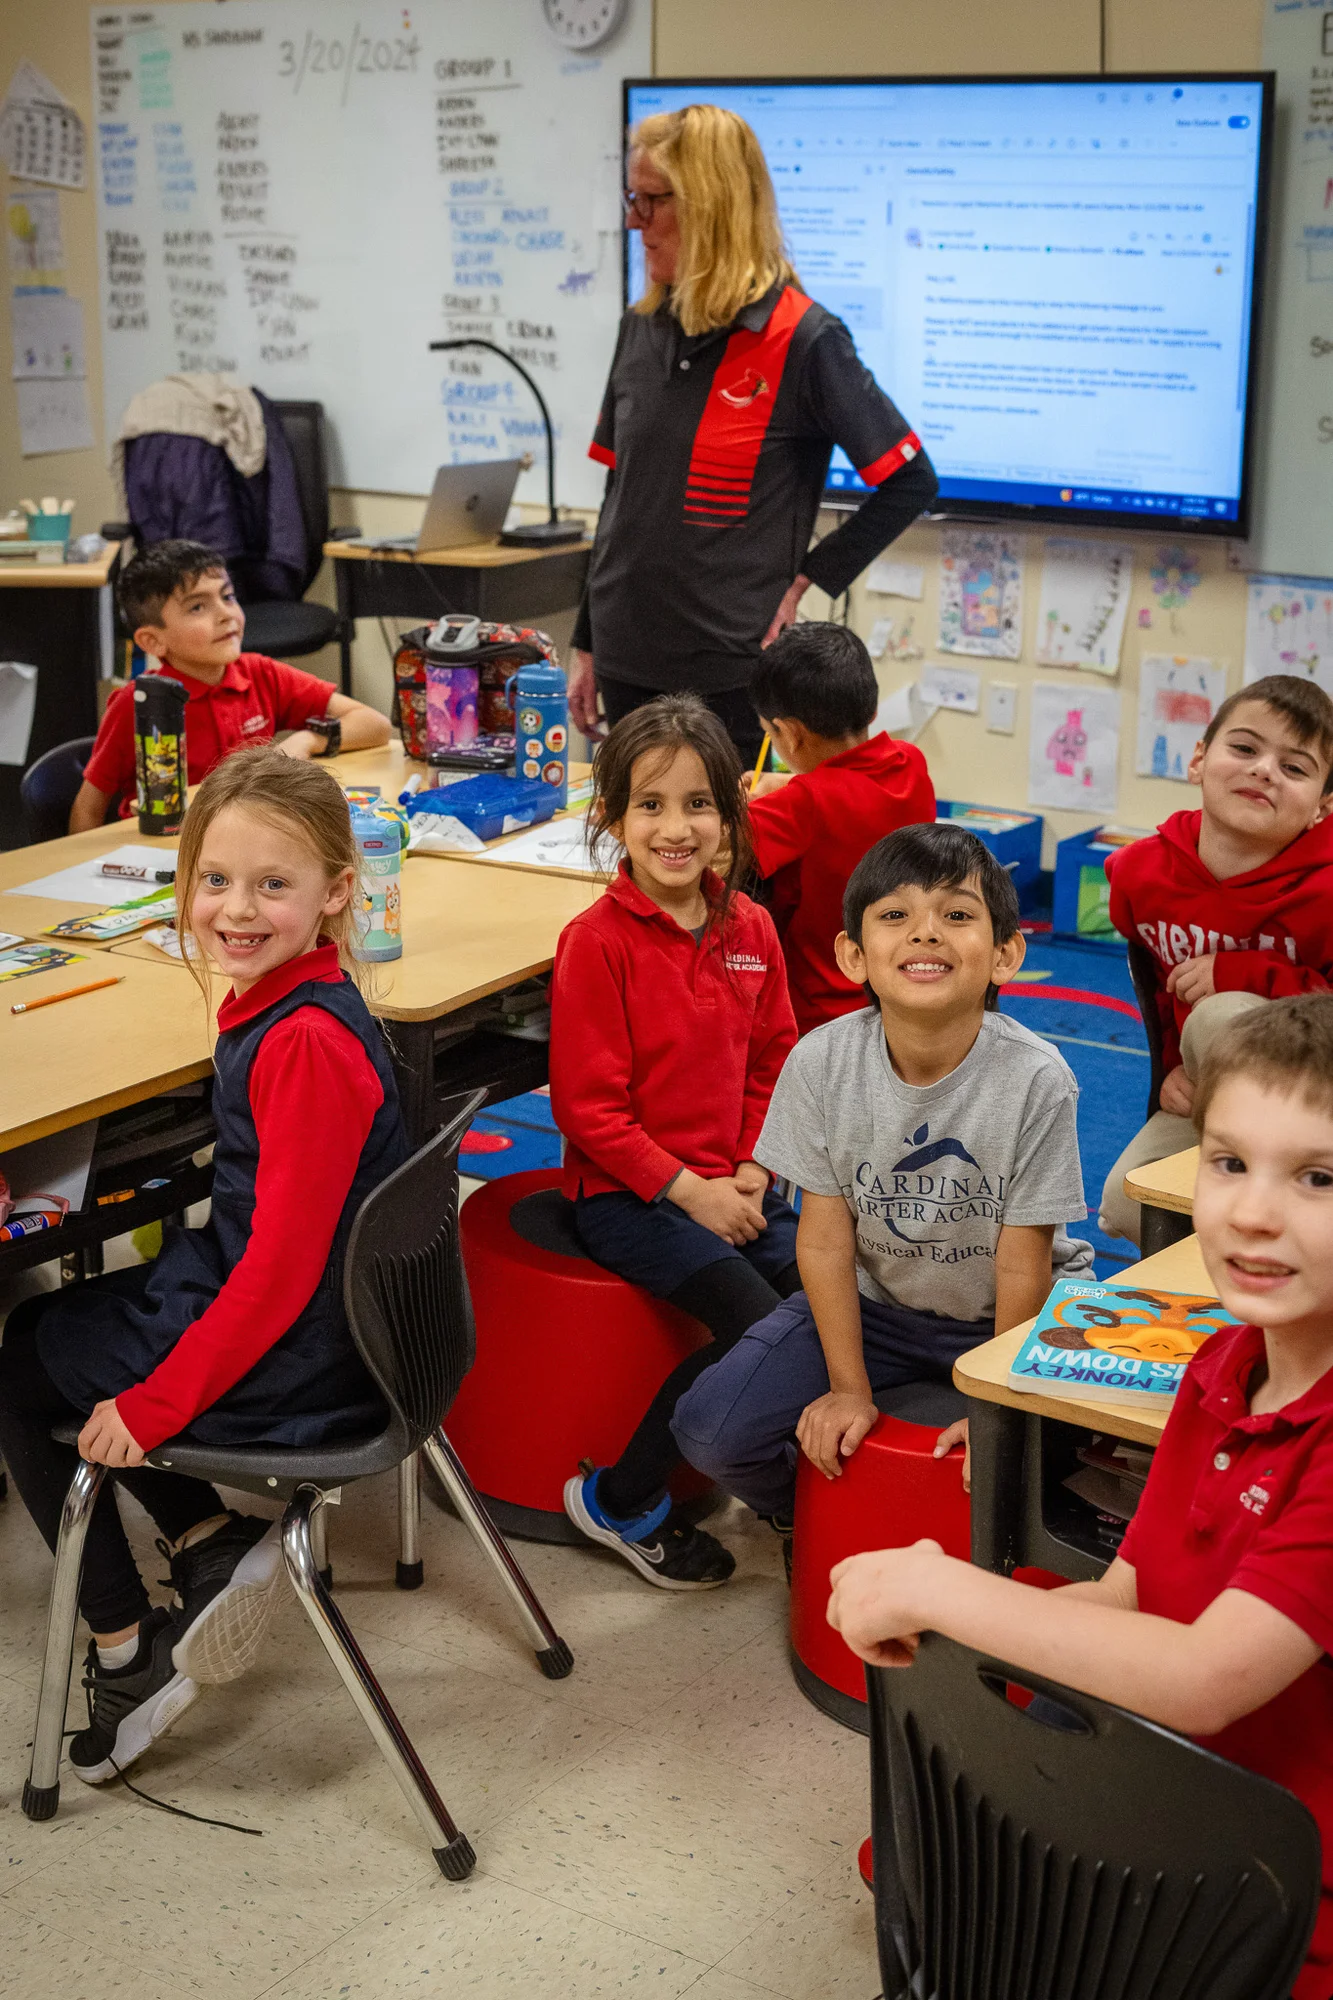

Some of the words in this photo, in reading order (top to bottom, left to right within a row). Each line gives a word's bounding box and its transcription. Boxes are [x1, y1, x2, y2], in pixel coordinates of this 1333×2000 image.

[278, 22, 421, 107] 3/20/2024
[930, 1244, 998, 1264] Educa
[1026, 1346, 1143, 1374] DOWN
[1022, 1363, 1150, 1389] MONKEY
